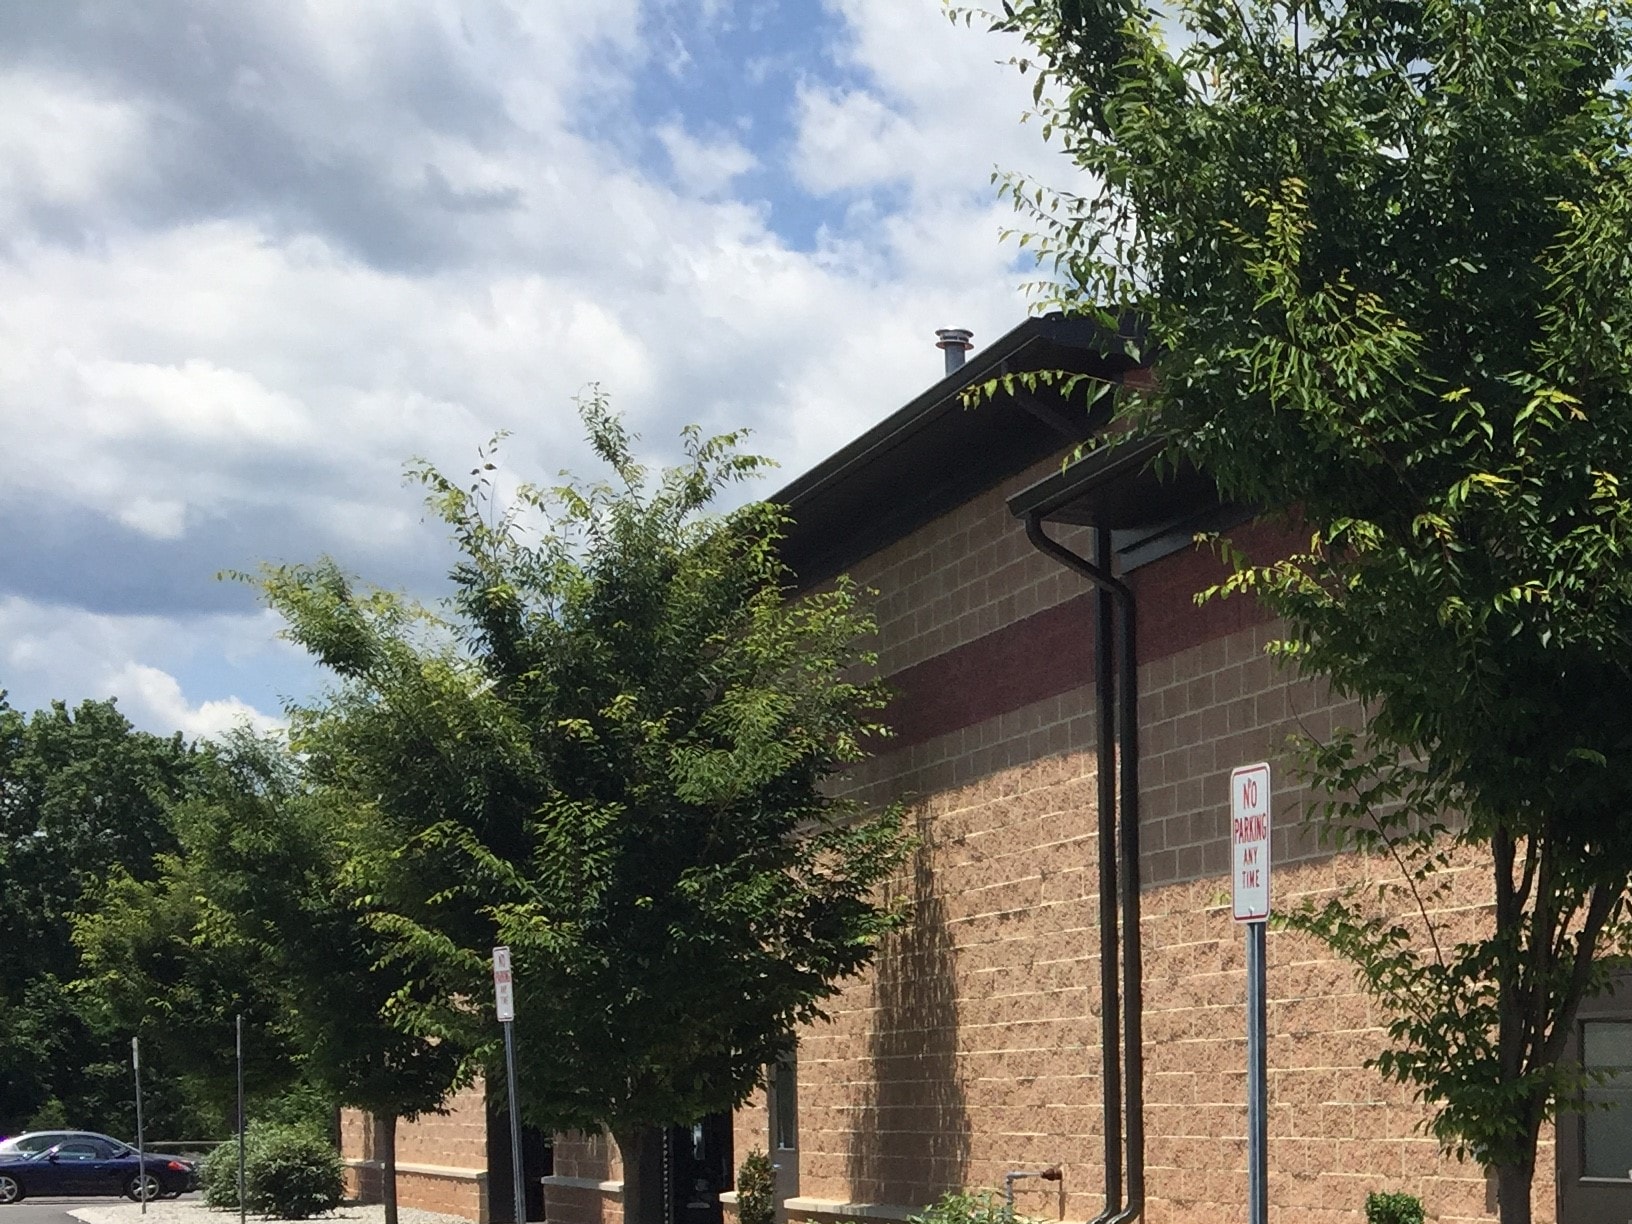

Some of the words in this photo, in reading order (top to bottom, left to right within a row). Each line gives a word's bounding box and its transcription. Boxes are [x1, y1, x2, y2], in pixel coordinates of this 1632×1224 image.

[1243, 781, 1257, 809] NO
[1234, 813, 1266, 844] PARKING
[1243, 847, 1258, 867] ANY
[1242, 869, 1260, 889] TIME
